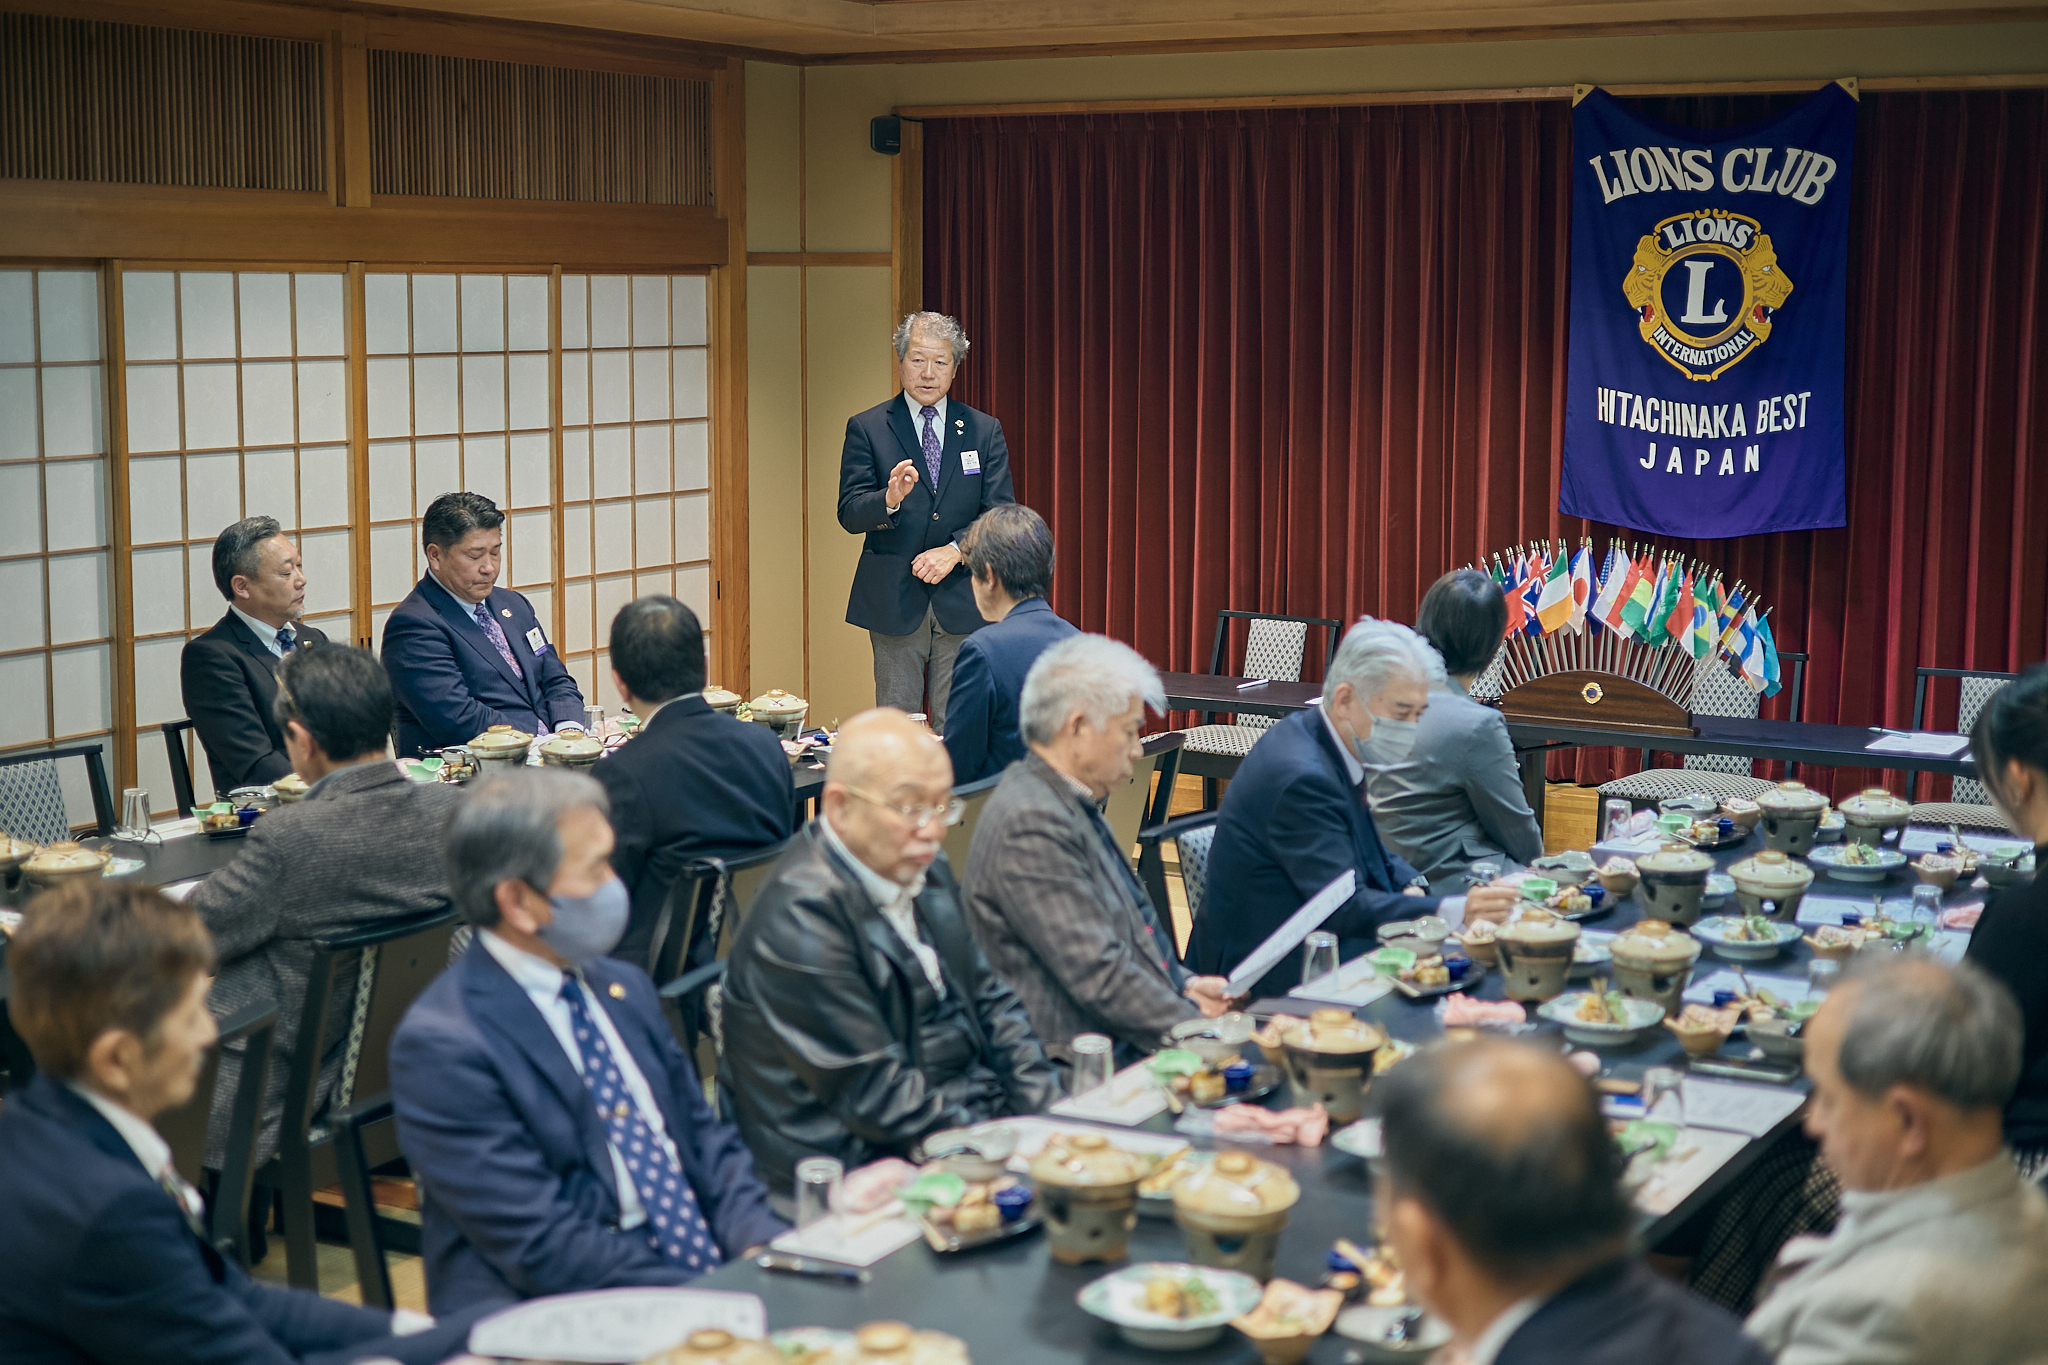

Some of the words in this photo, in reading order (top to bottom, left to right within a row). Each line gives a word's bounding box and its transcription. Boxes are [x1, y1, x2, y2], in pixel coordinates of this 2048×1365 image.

[1589, 146, 1714, 204] LIONS
[1721, 147, 1837, 205] CLUB
[1661, 217, 1754, 248] LIONS
[1680, 260, 1729, 324] L
[1652, 326, 1755, 366] INTERNATIONAL
[1597, 387, 1747, 439] HITACHINAKA
[1755, 391, 1812, 435] BEST
[1639, 442, 1761, 476] JAPAN
